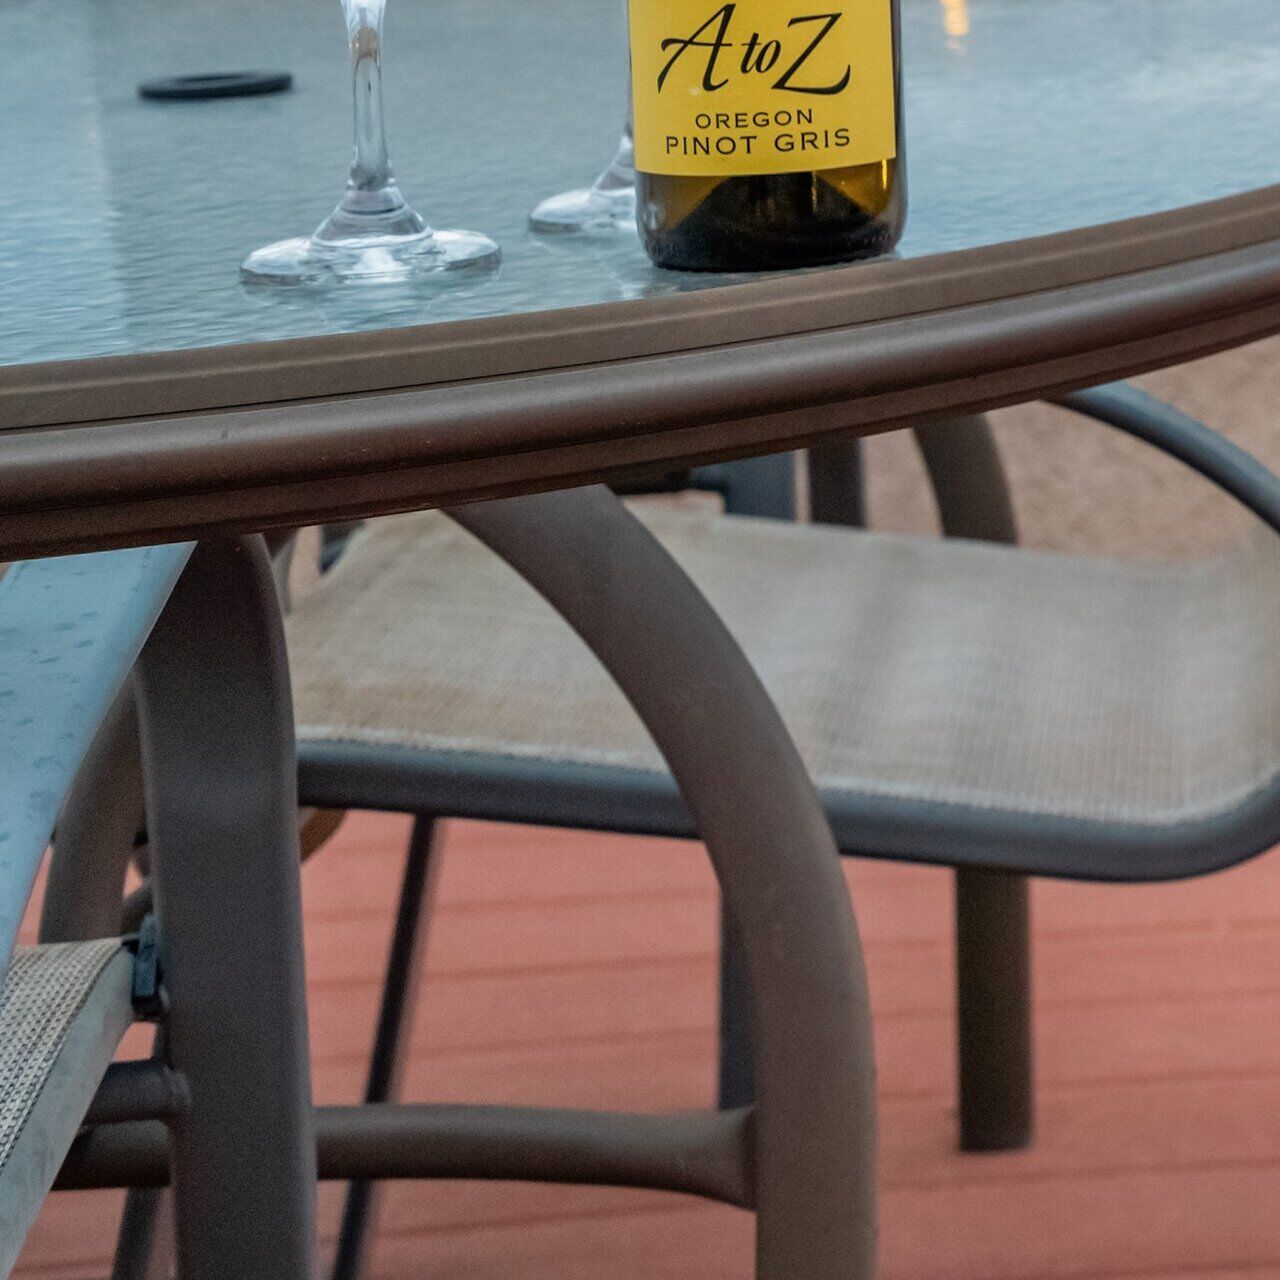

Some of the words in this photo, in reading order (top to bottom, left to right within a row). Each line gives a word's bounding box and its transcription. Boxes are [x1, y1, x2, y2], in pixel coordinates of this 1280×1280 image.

[657, 3, 736, 94] A
[740, 32, 782, 75] to
[771, 12, 851, 95] Z
[695, 108, 813, 129] OREGON
[665, 135, 757, 155] PINOT
[773, 128, 851, 153] GRIS
